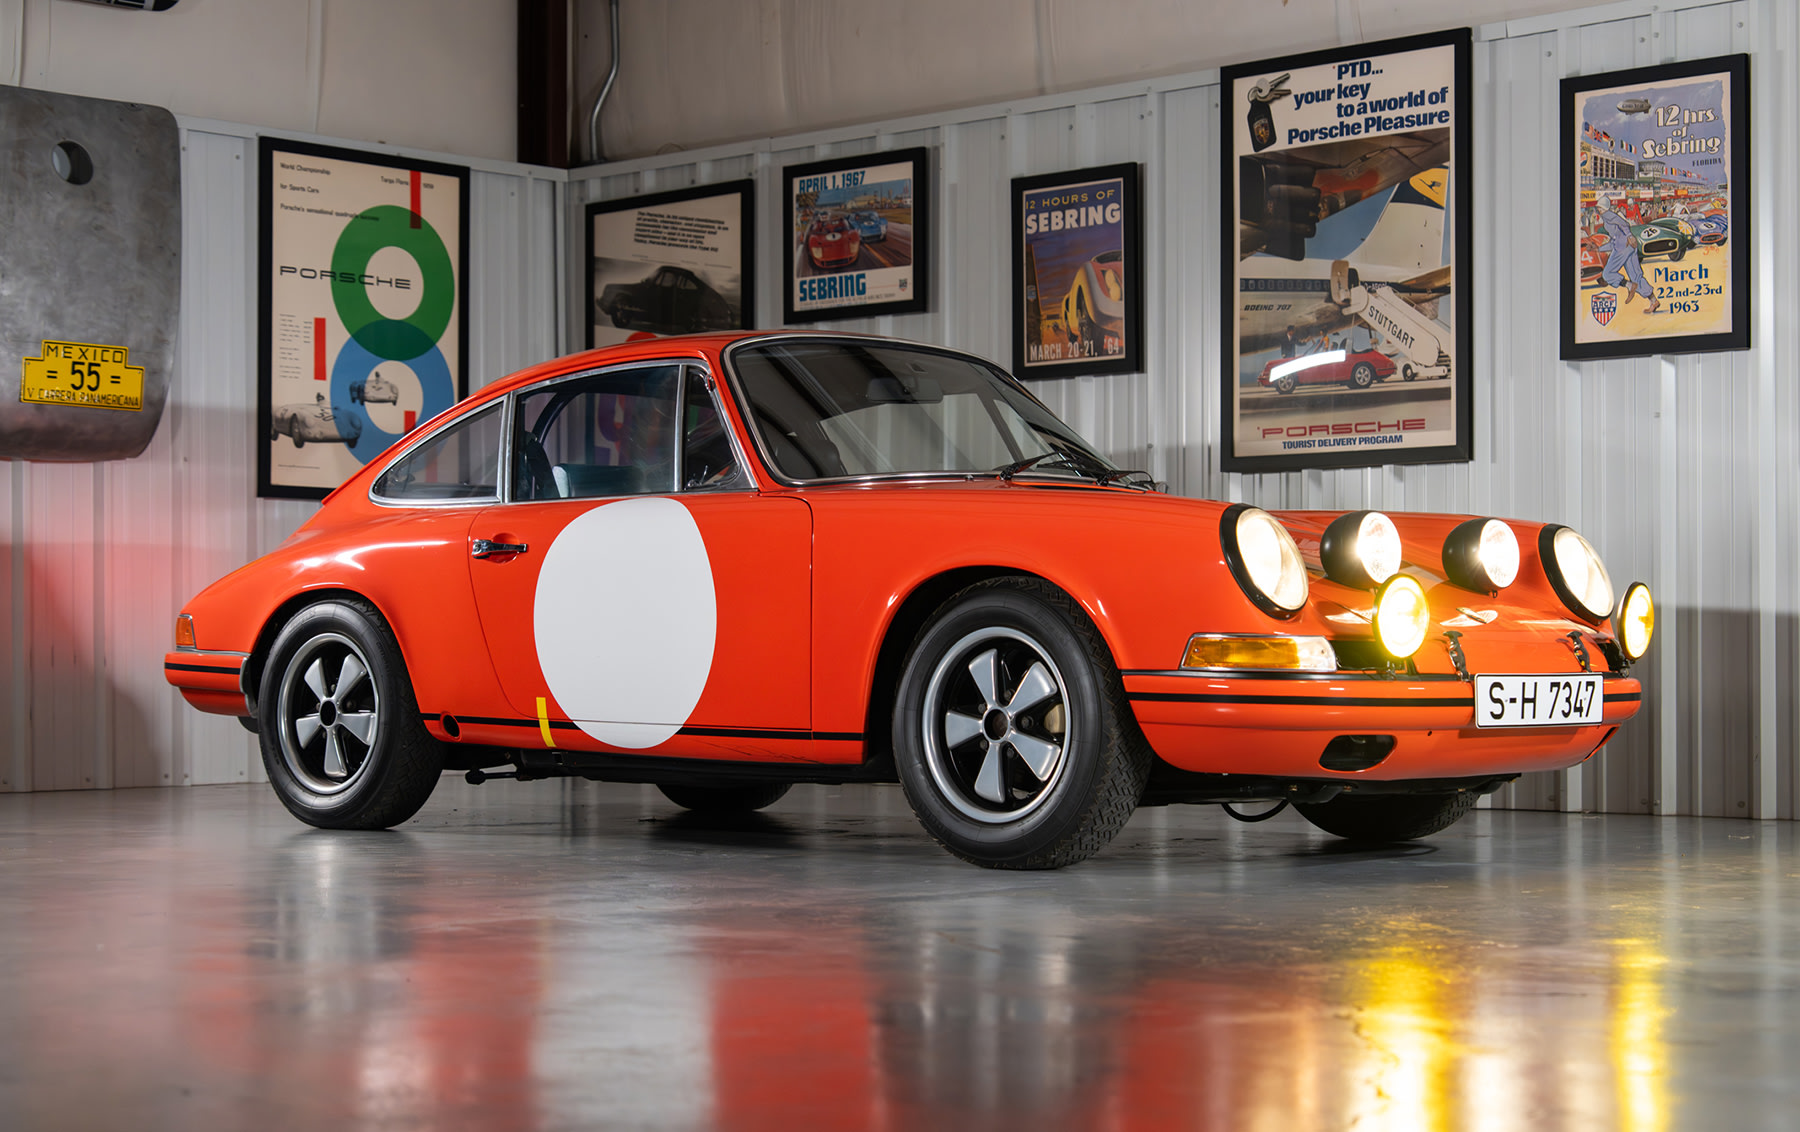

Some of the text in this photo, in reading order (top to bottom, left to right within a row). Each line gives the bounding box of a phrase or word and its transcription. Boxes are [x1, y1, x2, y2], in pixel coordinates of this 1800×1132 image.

[1293, 82, 1371, 111] your key
[1336, 86, 1449, 118] to a world of
[1655, 104, 1681, 128] 12
[1287, 109, 1450, 145] Porsche Pleasure
[1672, 126, 1688, 139] of
[1642, 134, 1722, 160] Sebring
[280, 162, 295, 170] World
[1692, 157, 1722, 167] FLORIDA
[289, 183, 306, 192] Sports
[307, 185, 320, 194] Cars
[799, 175, 828, 194] APRIL
[841, 170, 866, 188] 1967
[1025, 189, 1116, 210] 12 HOURS OF
[1026, 202, 1121, 235] SEBRING
[1643, 227, 1658, 238] 26
[279, 265, 411, 290] PORSCHE
[1654, 263, 1709, 283] March
[799, 273, 867, 302] SEBRING
[1656, 284, 1723, 299] 22nd-23rd
[1276, 303, 1293, 311] 707
[1668, 300, 1700, 314] 1963
[1368, 305, 1415, 349] STUTTGART
[46, 344, 124, 364] MEXICO
[1029, 342, 1062, 362] MARCH
[1067, 338, 1098, 358] 20-21,
[70, 361, 101, 392] 55
[27, 387, 140, 407] V CARRERA PANAMERICANA
[1262, 418, 1426, 439] PORSCHE
[1282, 434, 1403, 450] TOURIST DELIVERY PROGRAM
[1489, 680, 1596, 720] S-H 7347
